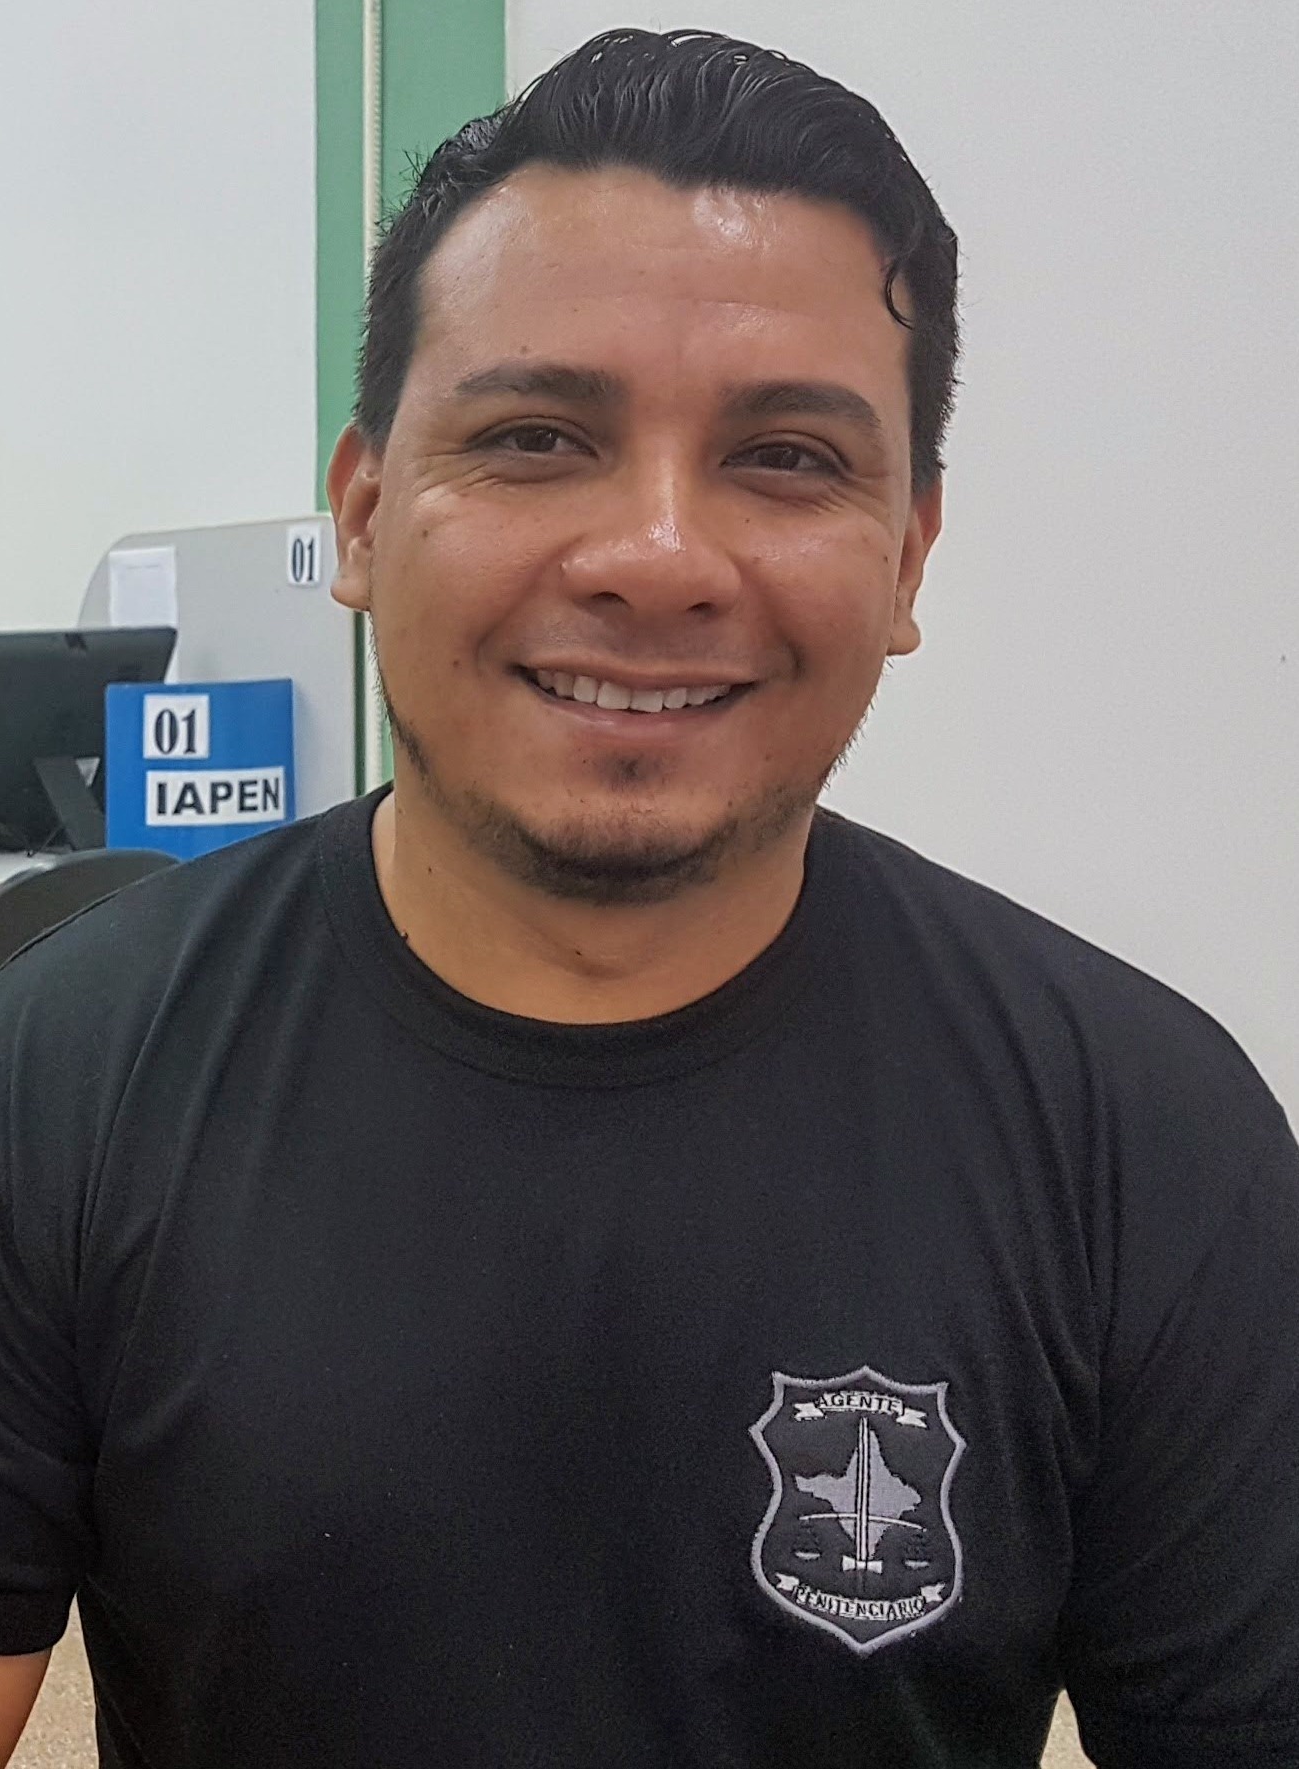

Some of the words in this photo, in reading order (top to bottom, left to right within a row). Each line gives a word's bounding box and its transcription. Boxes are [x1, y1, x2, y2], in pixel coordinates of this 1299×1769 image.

[292, 537, 314, 582] 01
[155, 708, 197, 755] 01
[156, 777, 280, 815] IAPEN
[817, 1392, 904, 1413] AGENTE
